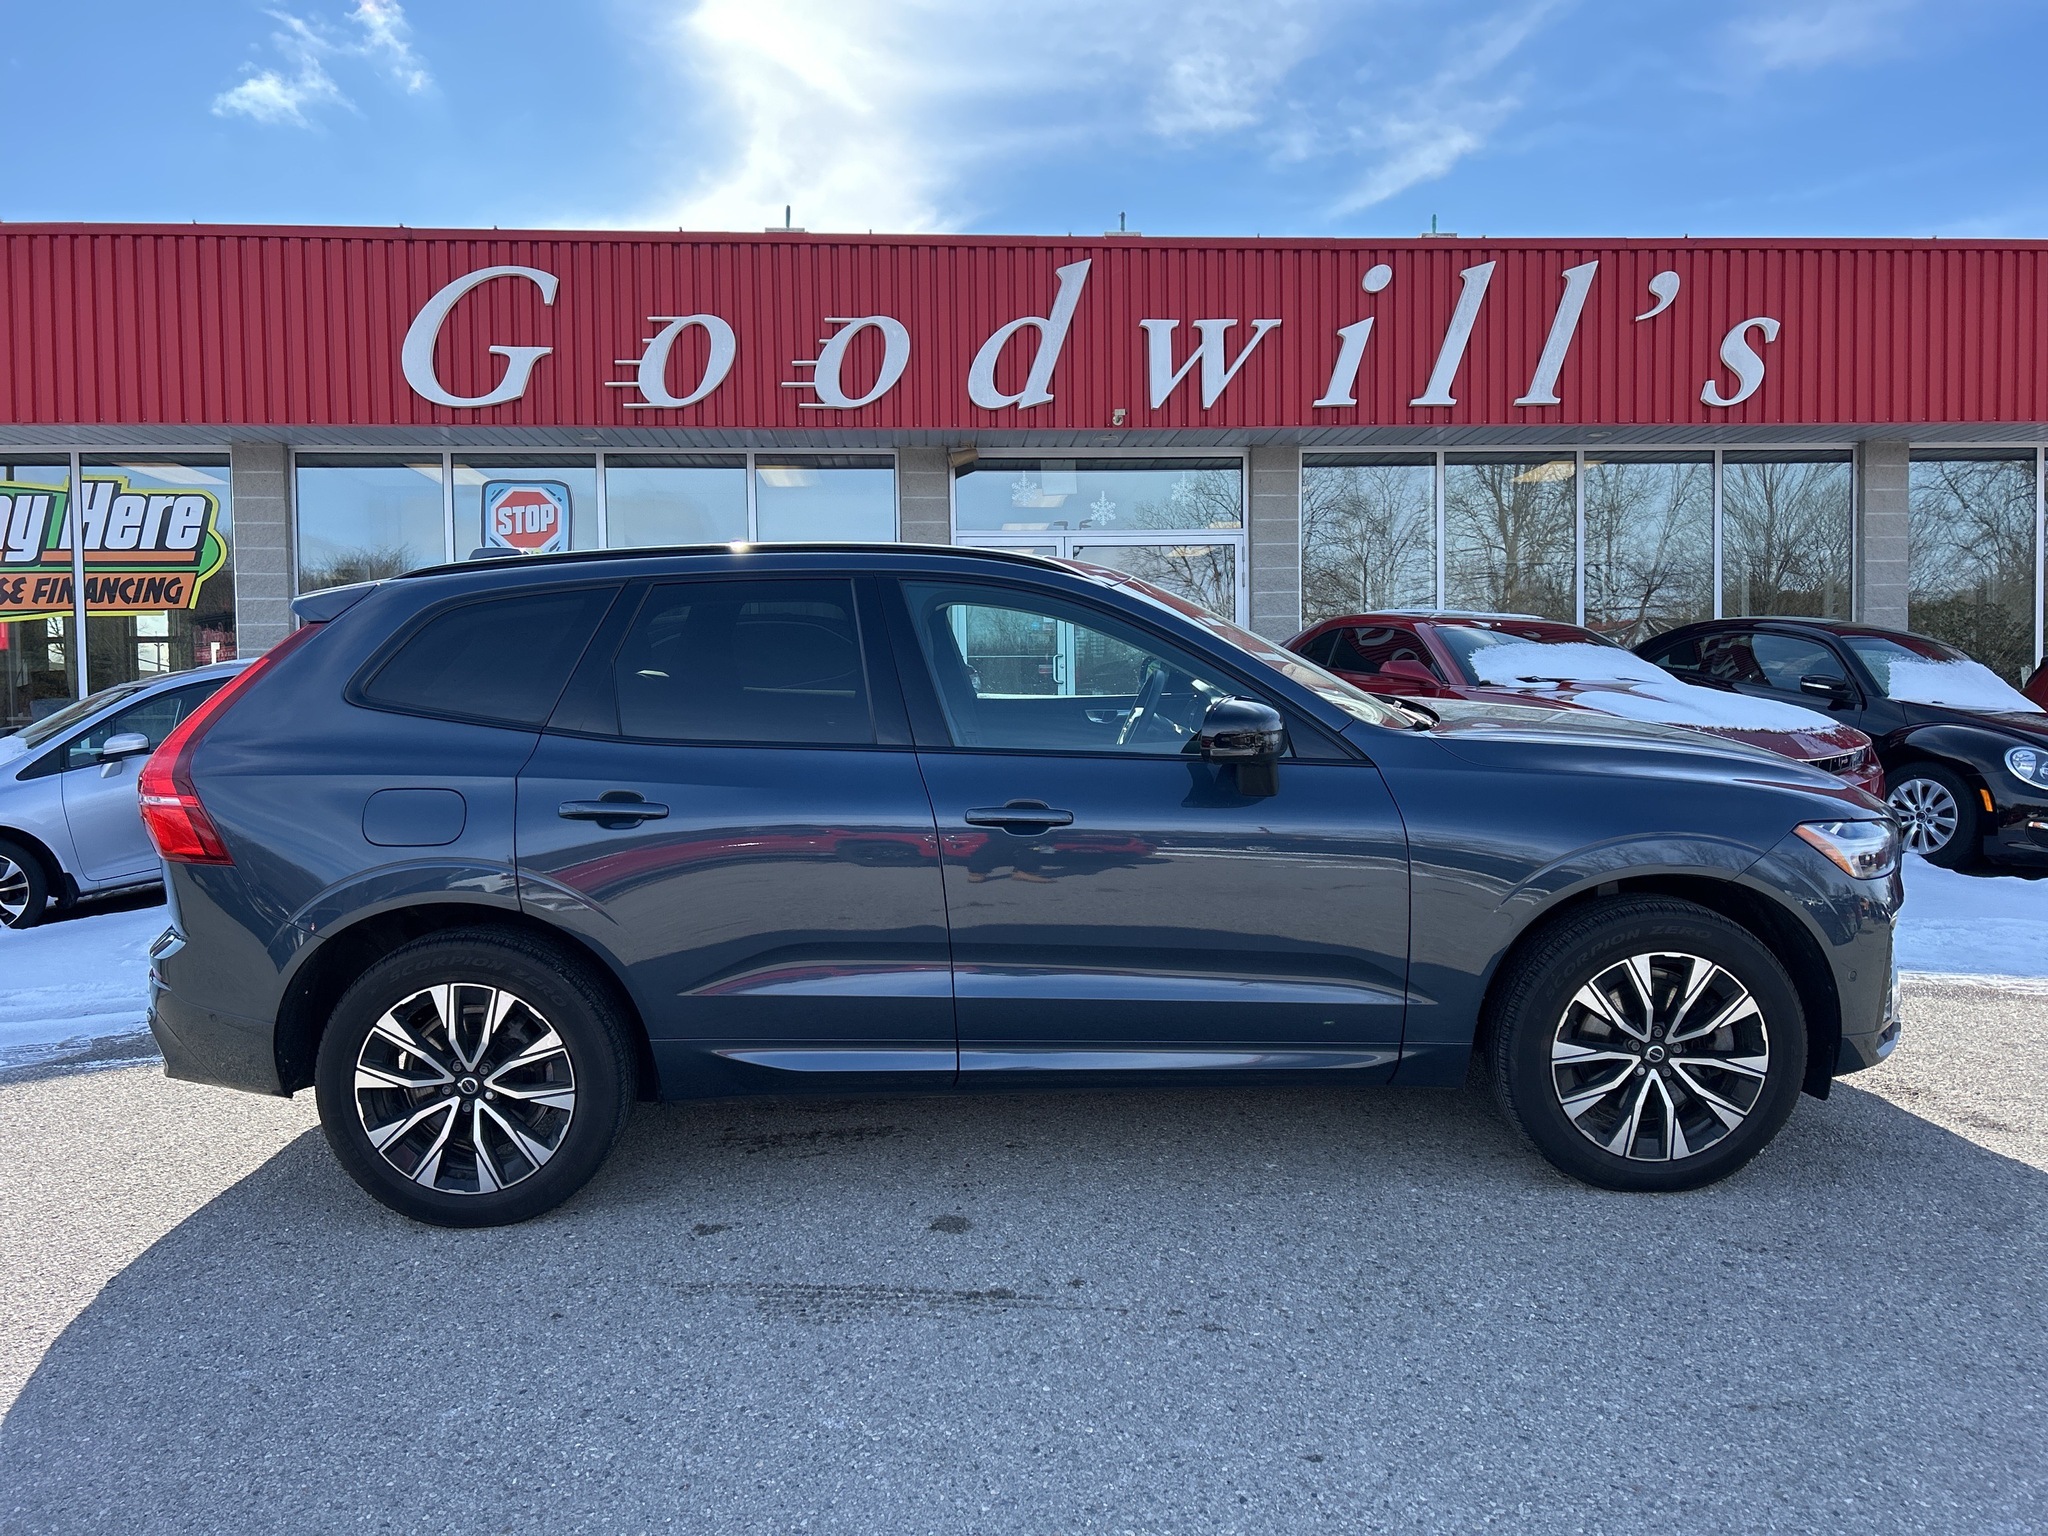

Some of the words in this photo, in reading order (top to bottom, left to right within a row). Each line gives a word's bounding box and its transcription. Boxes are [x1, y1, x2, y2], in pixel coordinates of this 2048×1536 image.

[401, 258, 1781, 411] Goodwill's
[60, 483, 206, 549] Here
[498, 504, 555, 536] STOP
[389, 956, 505, 983] SCORPION
[511, 969, 567, 1007] ZERO
[1547, 929, 1641, 998] SCORPION
[1651, 926, 1712, 939] ZERO
